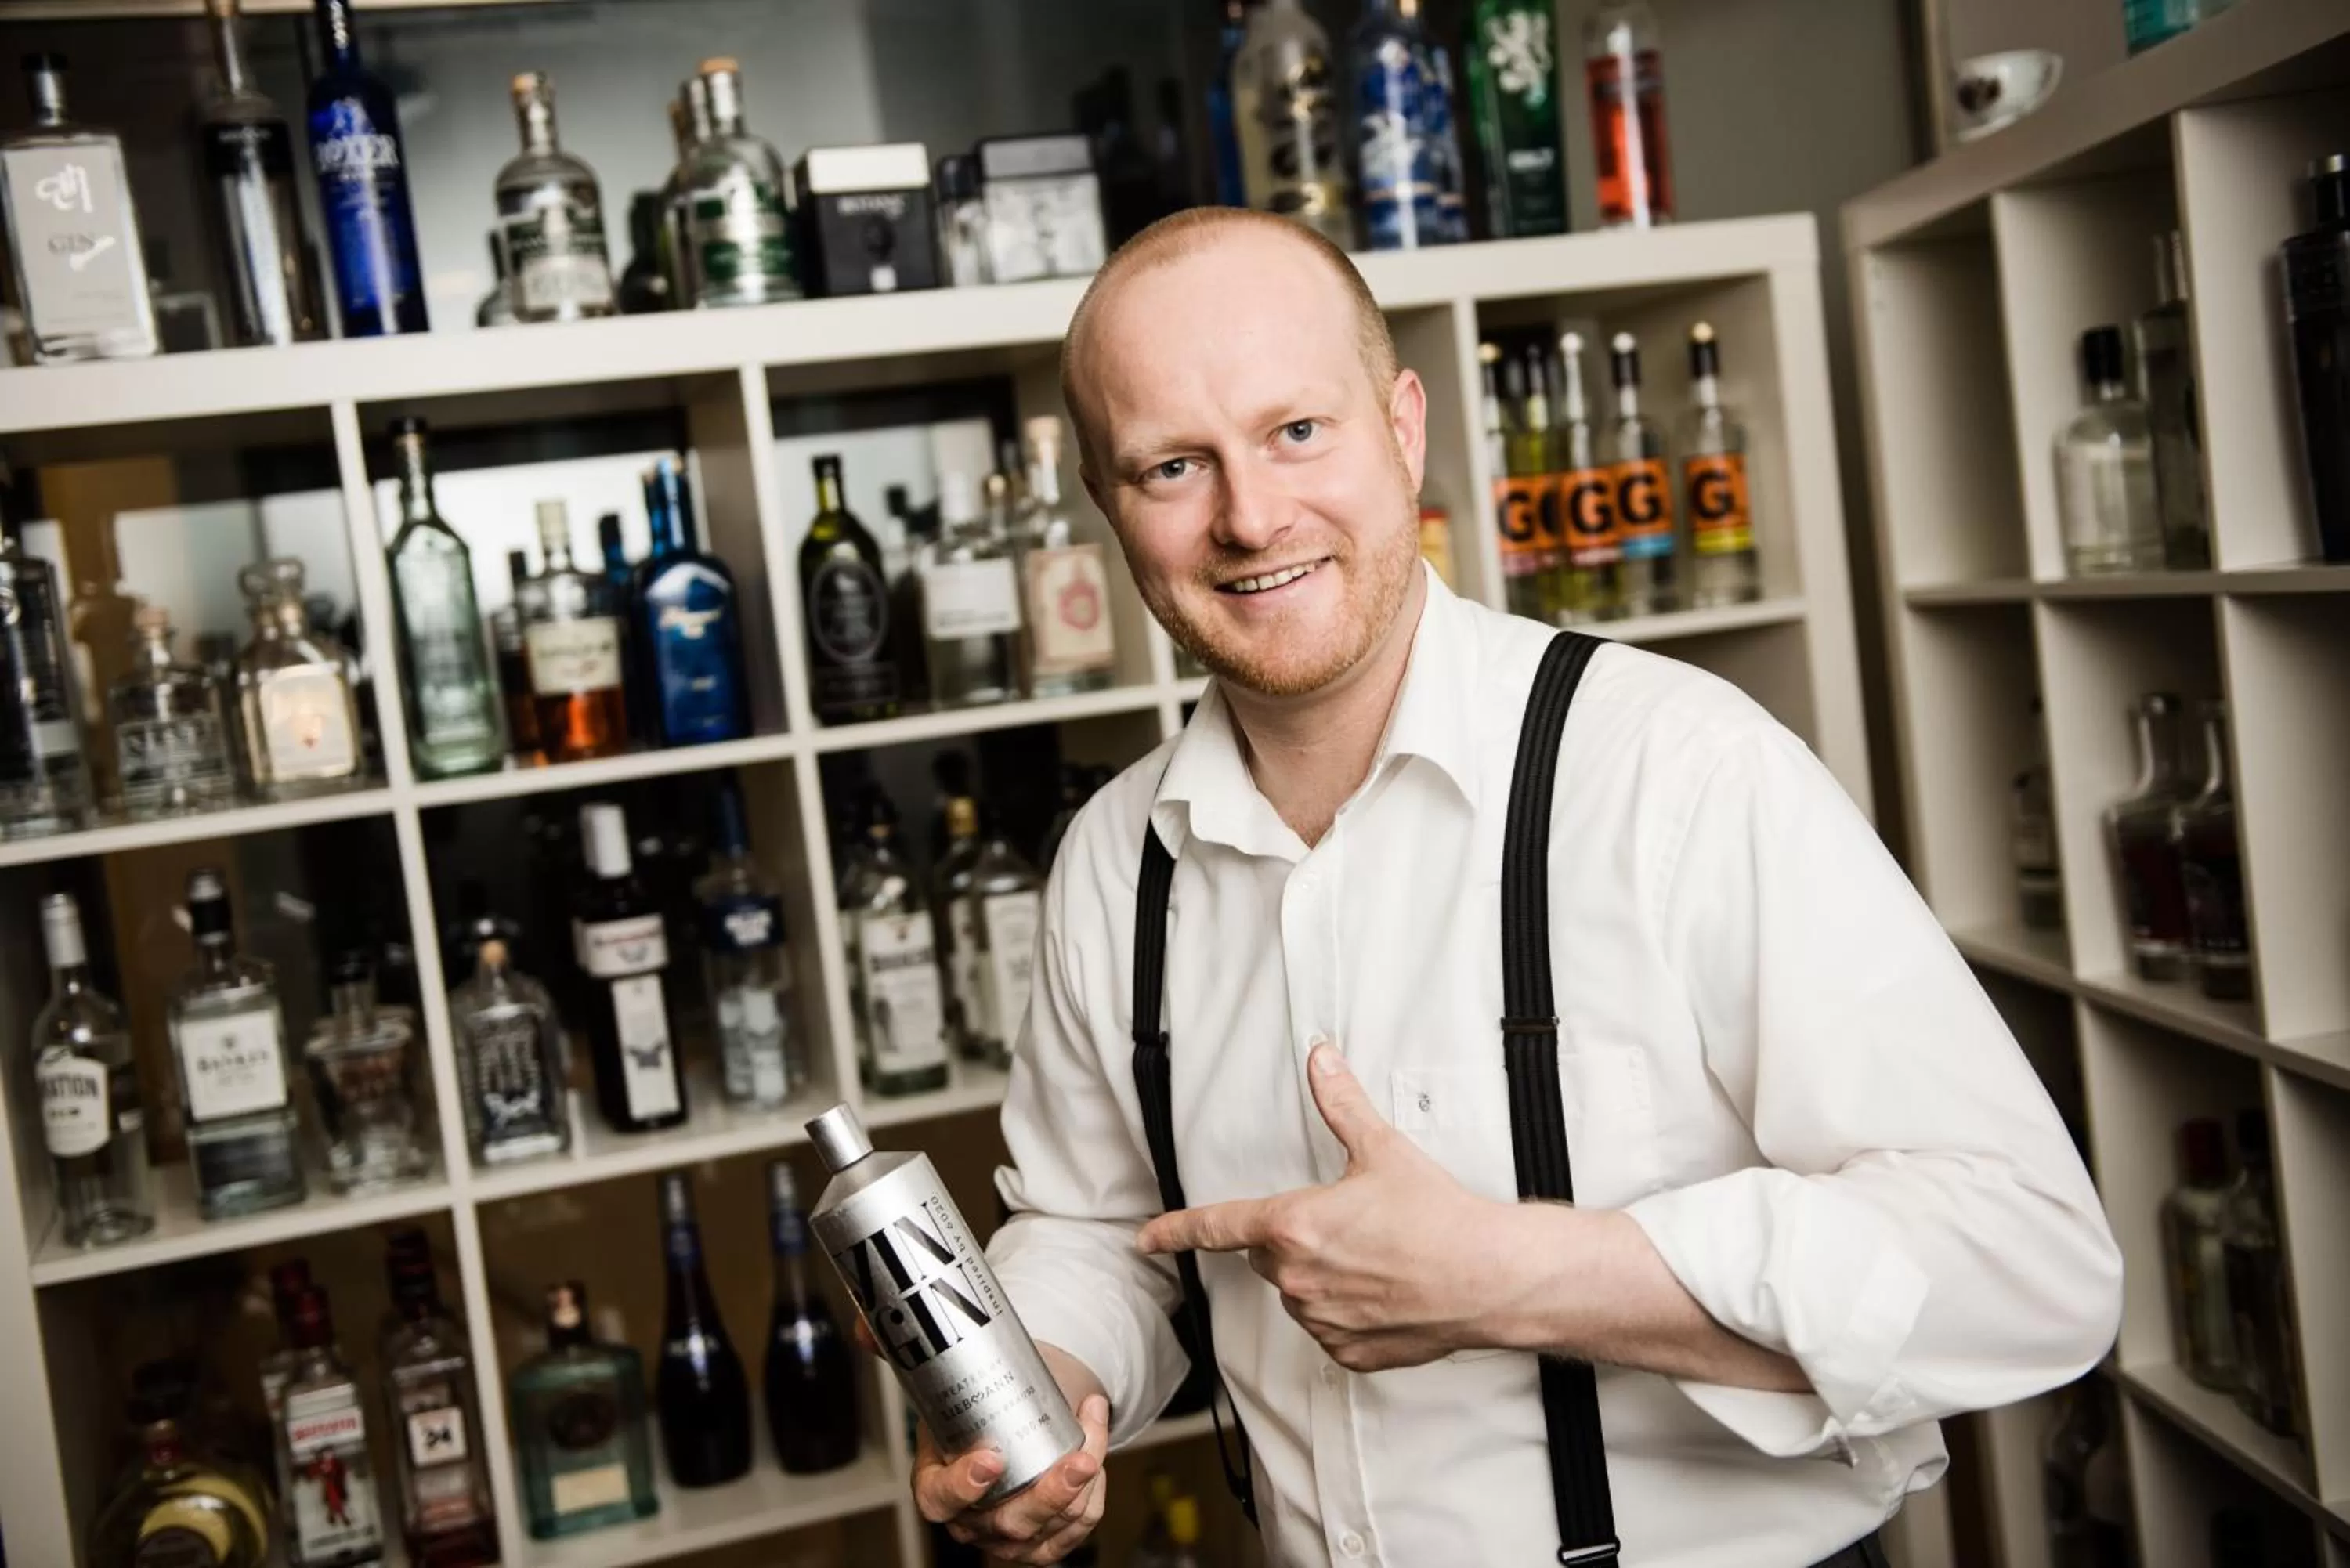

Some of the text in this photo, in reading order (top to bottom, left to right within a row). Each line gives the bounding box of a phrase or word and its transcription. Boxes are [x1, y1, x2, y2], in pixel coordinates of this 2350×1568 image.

[1569, 479, 1614, 536] G
[1617, 472, 1664, 527] G
[1691, 470, 1734, 520] G
[874, 1263, 992, 1371] GIN
